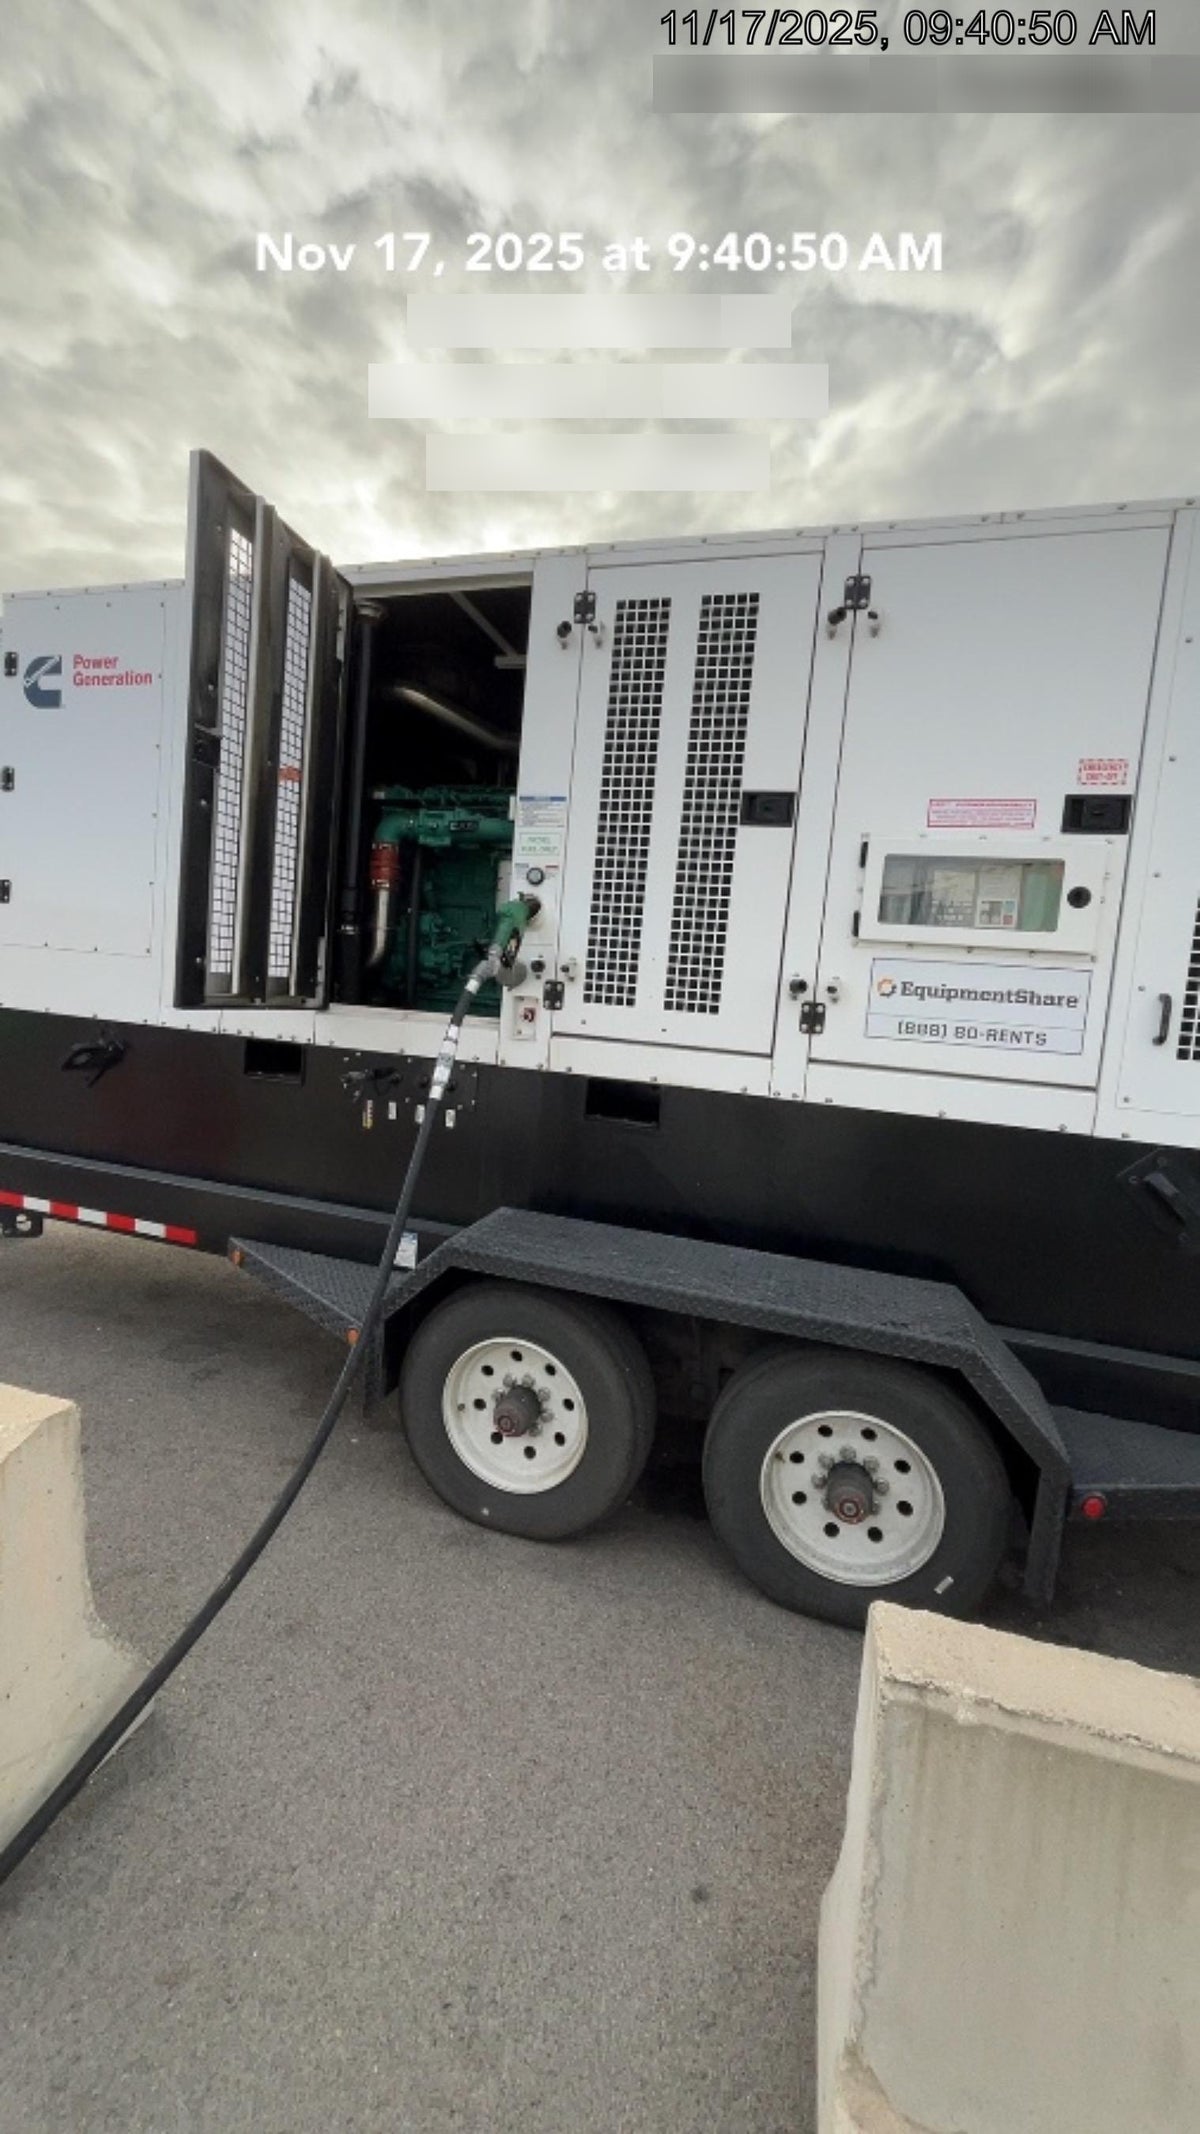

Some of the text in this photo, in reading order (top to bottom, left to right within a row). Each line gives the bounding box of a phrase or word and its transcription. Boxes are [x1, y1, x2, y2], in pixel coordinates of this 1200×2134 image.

[73, 654, 119, 669] Power
[73, 670, 153, 687] Generation
[901, 981, 1079, 1008] EquipmentShare
[954, 1025, 1047, 1047] 80-RENTS
